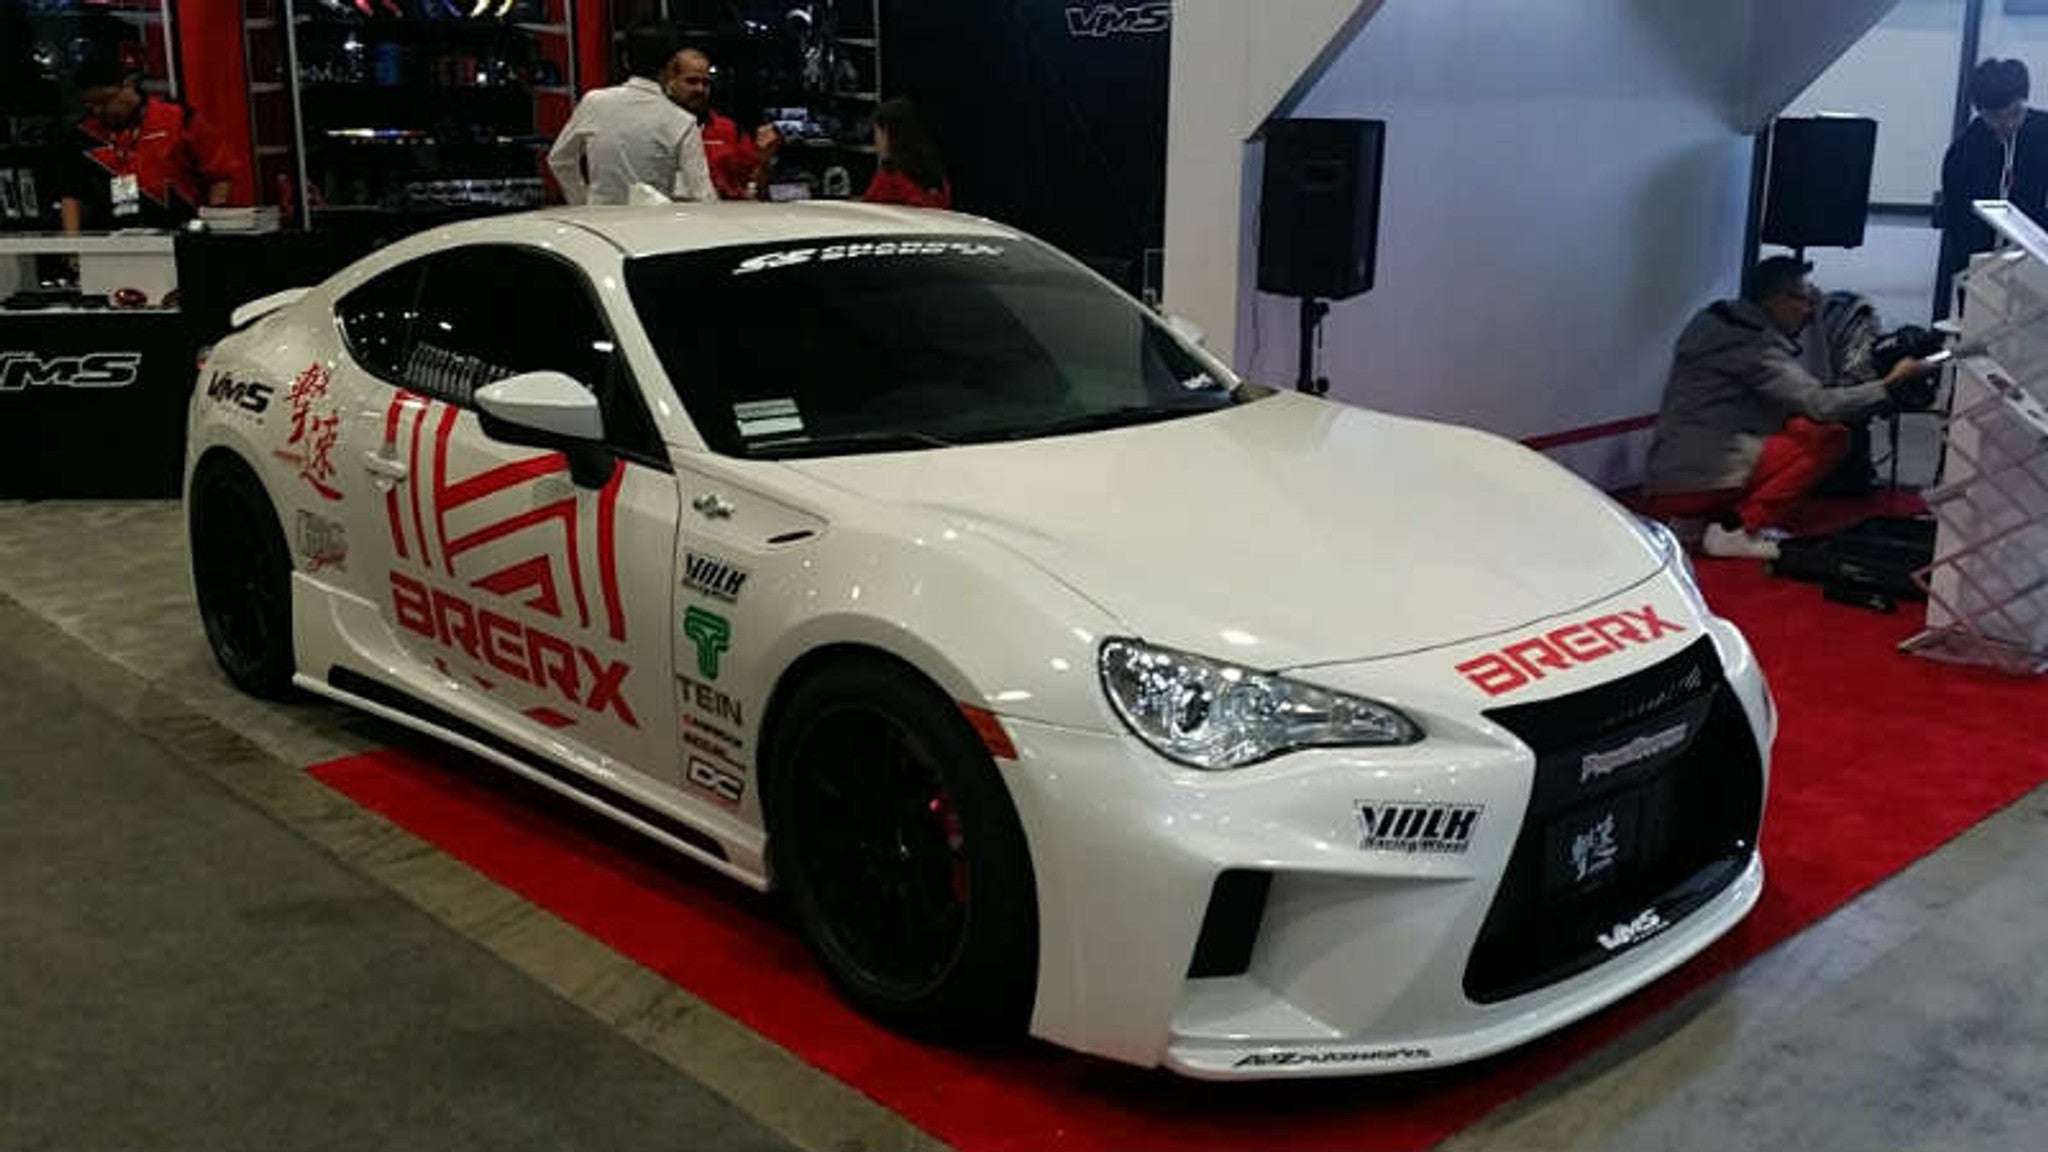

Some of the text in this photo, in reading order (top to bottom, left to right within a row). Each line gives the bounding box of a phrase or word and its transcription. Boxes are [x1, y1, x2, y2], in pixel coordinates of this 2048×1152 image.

[1065, 2, 1170, 37] VMS
[0, 351, 143, 391] MS
[207, 370, 275, 414] VMS
[686, 552, 747, 597] VOLK
[676, 673, 744, 728] TEIN
[1360, 804, 1480, 840] VOLK
[1597, 906, 1661, 950] VMS
